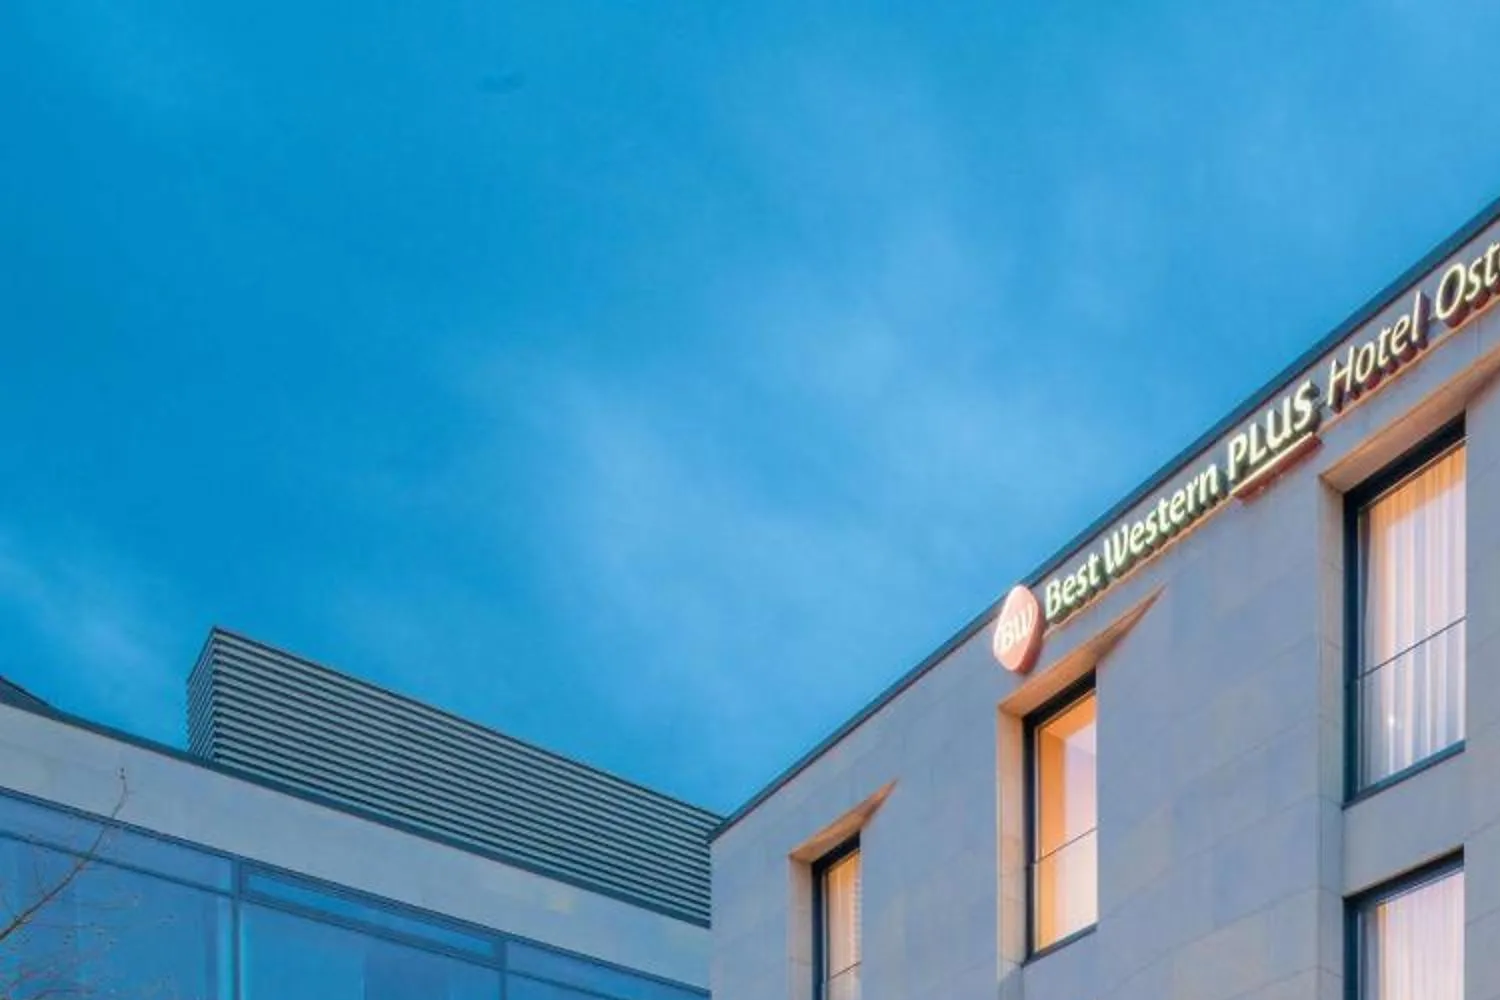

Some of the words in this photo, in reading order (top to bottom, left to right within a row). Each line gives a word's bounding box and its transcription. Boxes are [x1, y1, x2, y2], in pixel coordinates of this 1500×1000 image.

[1044, 550, 1102, 620] Best
[1103, 462, 1220, 573] Western
[1226, 380, 1312, 482] PLUS
[1327, 290, 1423, 406] Hotel
